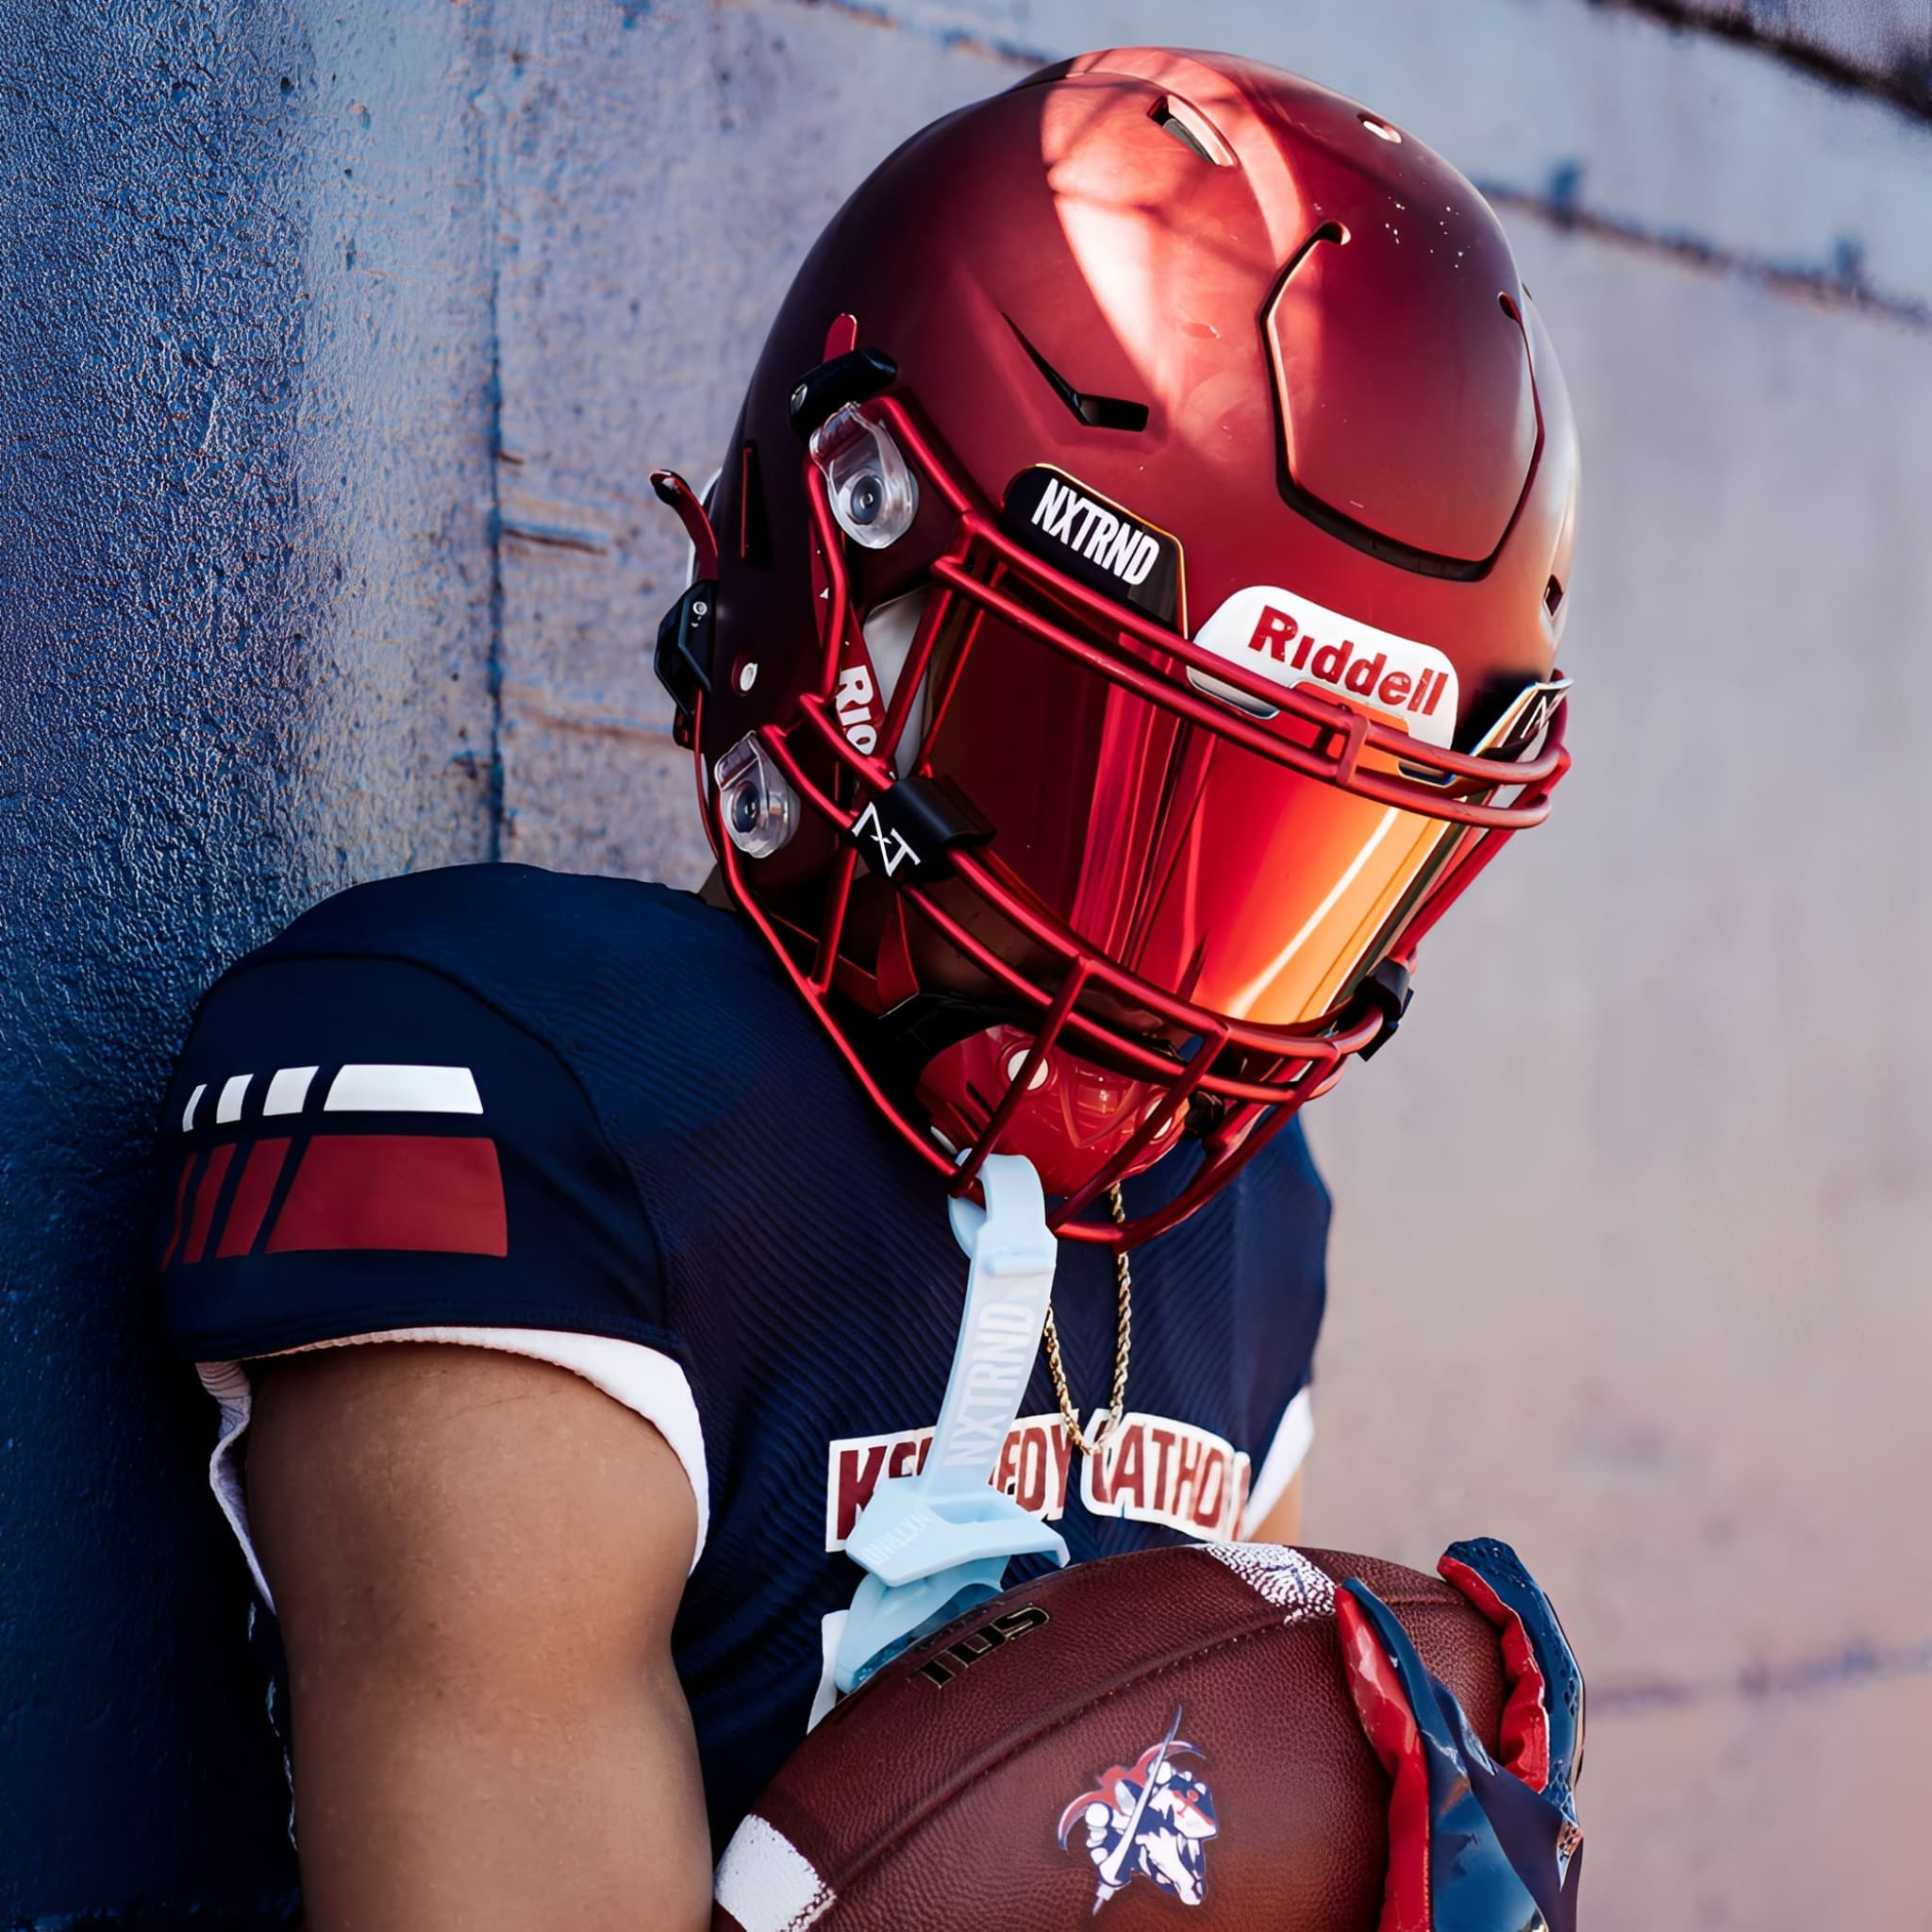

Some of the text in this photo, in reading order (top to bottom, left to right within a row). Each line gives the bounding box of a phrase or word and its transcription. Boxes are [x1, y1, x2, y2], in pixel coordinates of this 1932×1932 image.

[1031, 477, 1160, 586] NXTRND
[1247, 605, 1449, 716] Riddell
[943, 1302, 1035, 1467] NXTRND
